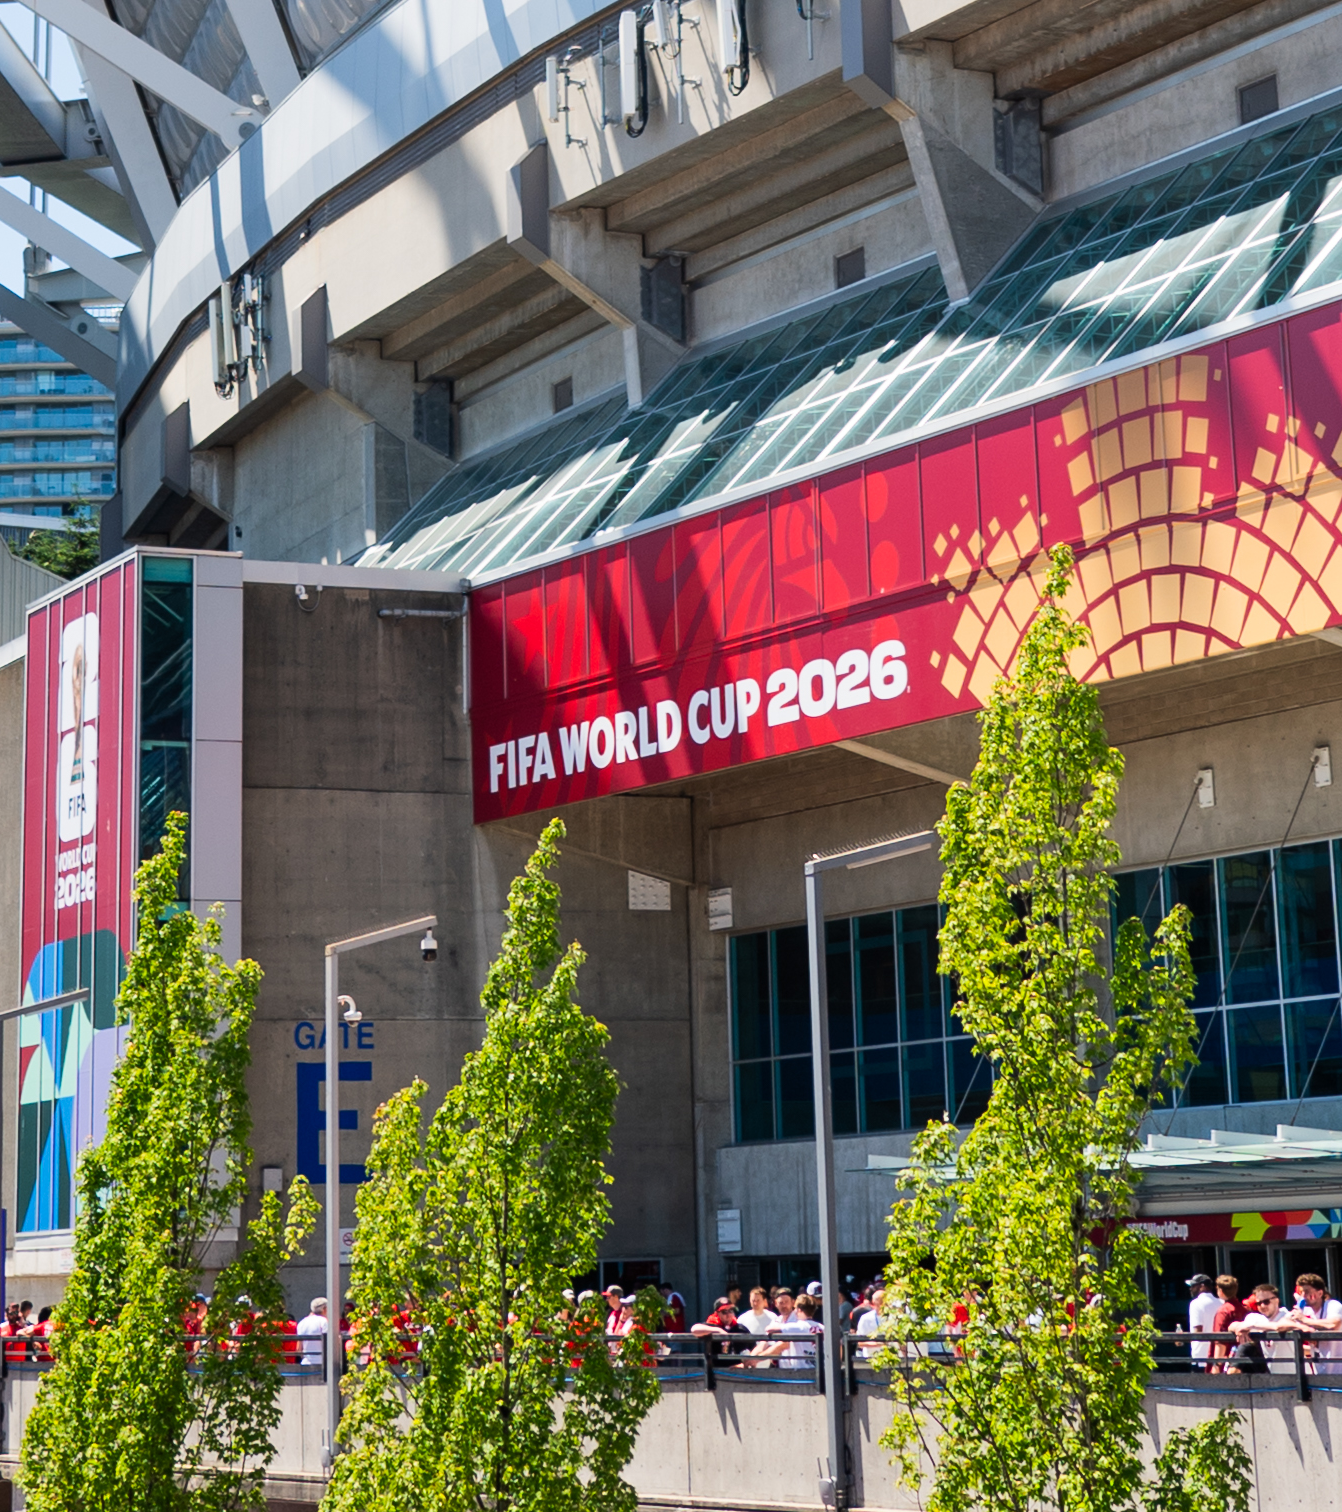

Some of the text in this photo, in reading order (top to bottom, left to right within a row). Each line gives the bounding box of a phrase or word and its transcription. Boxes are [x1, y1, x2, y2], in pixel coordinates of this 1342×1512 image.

[489, 639, 908, 793] FIFA WORLD CUP 2026
[68, 792, 87, 821] FIFA
[55, 866, 96, 910] 2026
[294, 1021, 375, 1050] GTE
[296, 1061, 373, 1184] E
